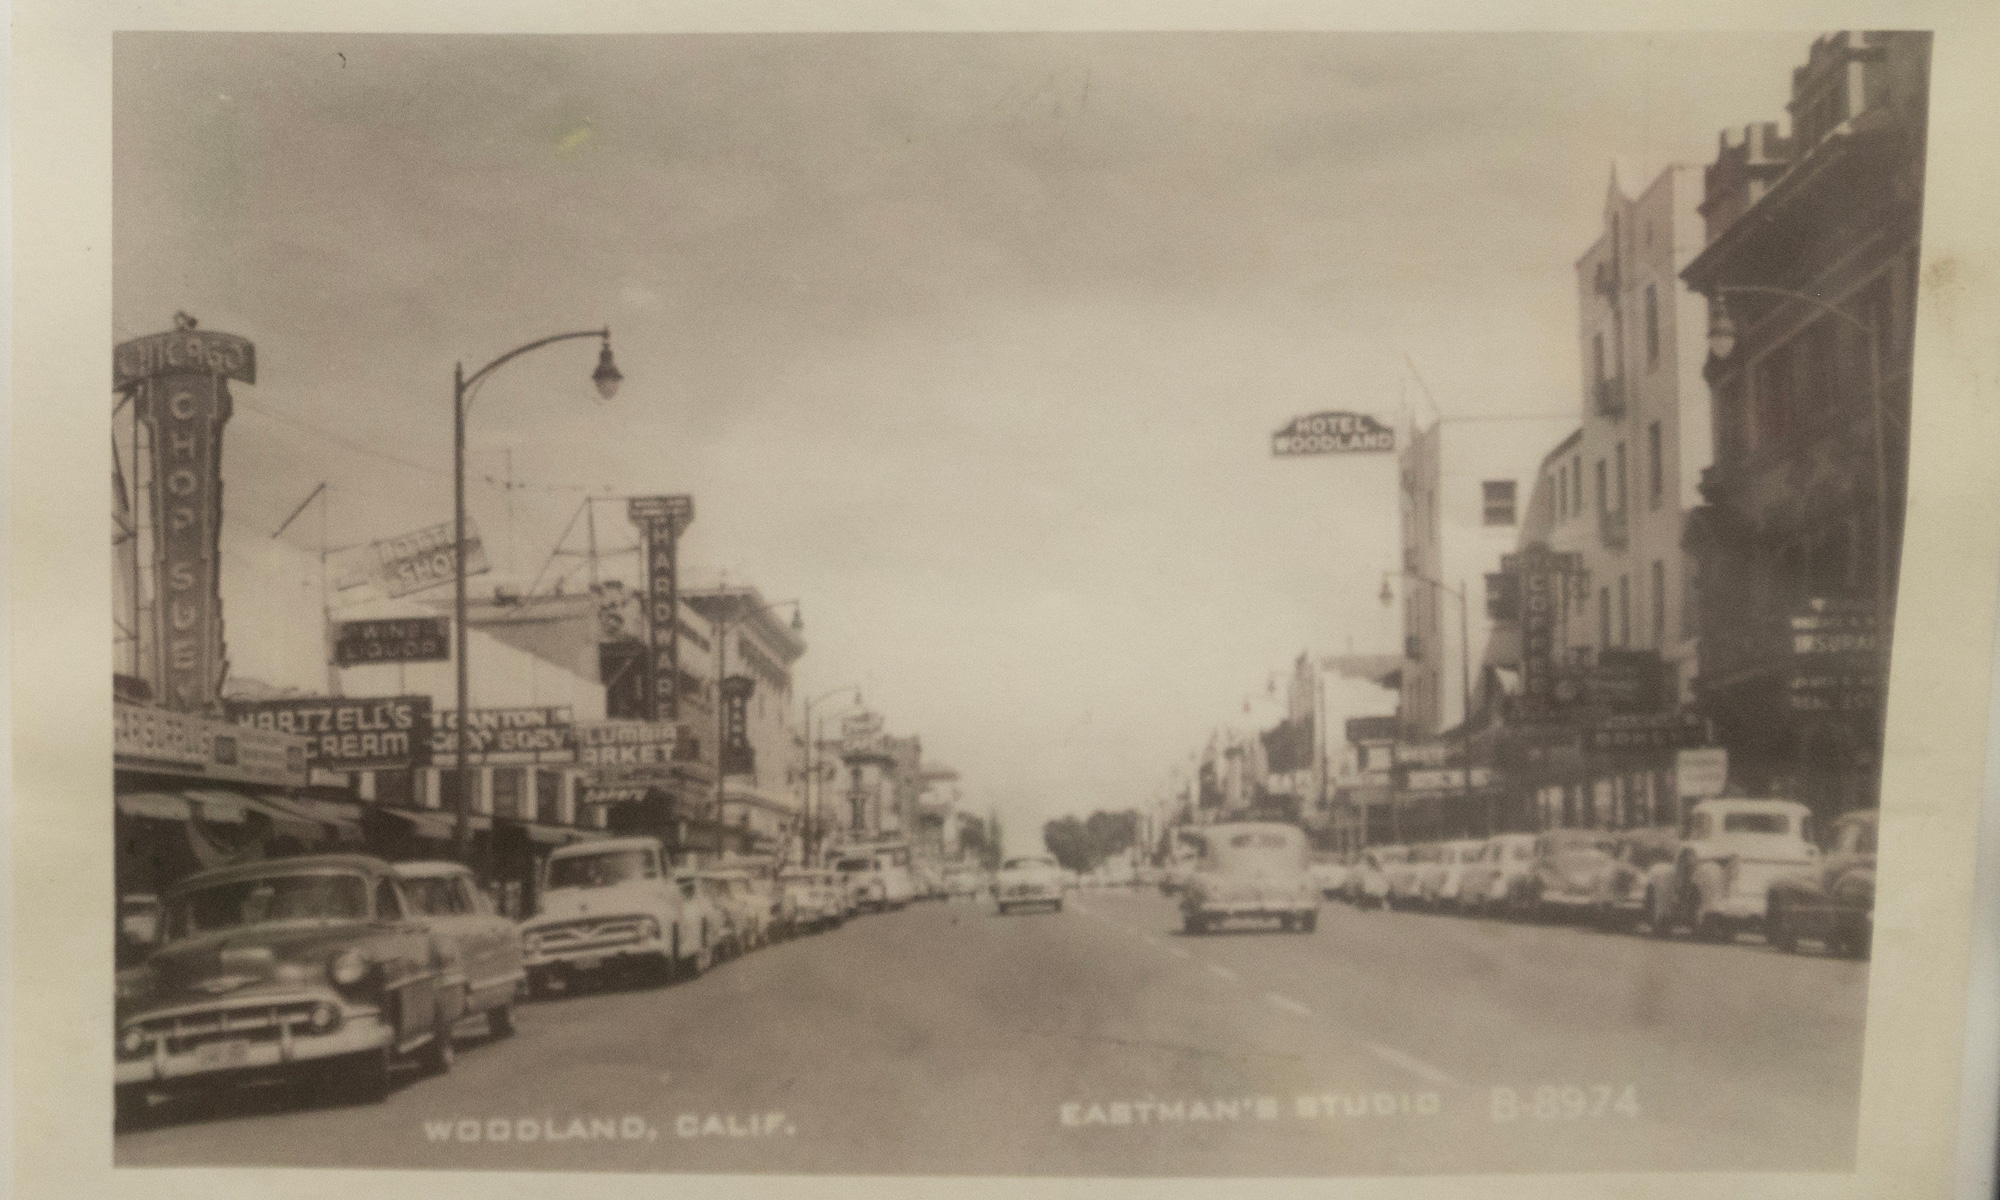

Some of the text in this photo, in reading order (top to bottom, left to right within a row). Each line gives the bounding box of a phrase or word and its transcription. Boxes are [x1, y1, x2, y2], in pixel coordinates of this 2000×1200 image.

[119, 336, 246, 376] CHICAGO
[1274, 433, 1394, 453] WOODLAND
[1296, 417, 1369, 434] HOTEL
[168, 391, 198, 533] CHOP
[398, 553, 457, 585] SHO
[653, 528, 674, 720] HARDWARE
